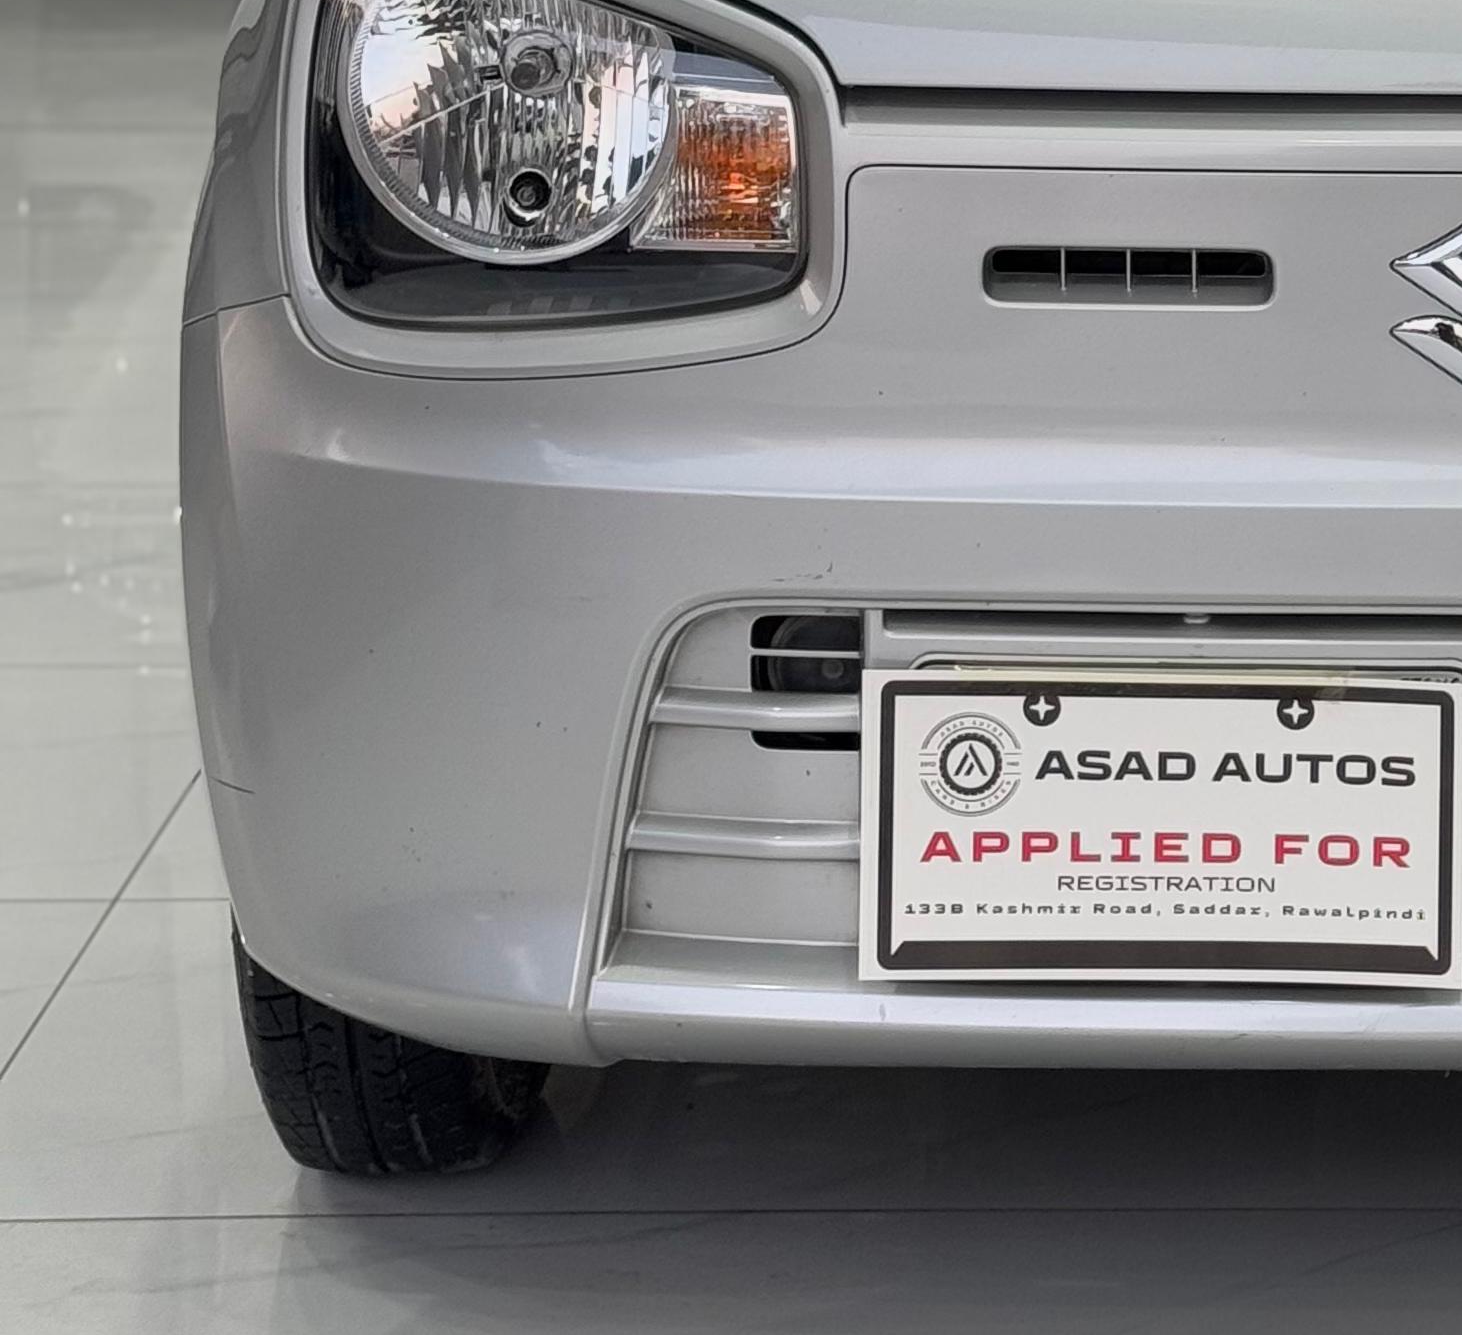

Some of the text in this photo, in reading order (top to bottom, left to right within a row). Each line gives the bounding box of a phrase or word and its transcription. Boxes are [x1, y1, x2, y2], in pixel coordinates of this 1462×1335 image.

[1034, 749, 1416, 787] ASAD AUTOS
[920, 831, 1410, 868] APPLIED FOR
[1057, 875, 1276, 893] REGISTRATION
[976, 902, 1081, 915] Kashmir
[1093, 903, 1161, 917] Road,
[1173, 903, 1270, 918] Saddar,
[1282, 905, 1426, 921] Rawalpindi
